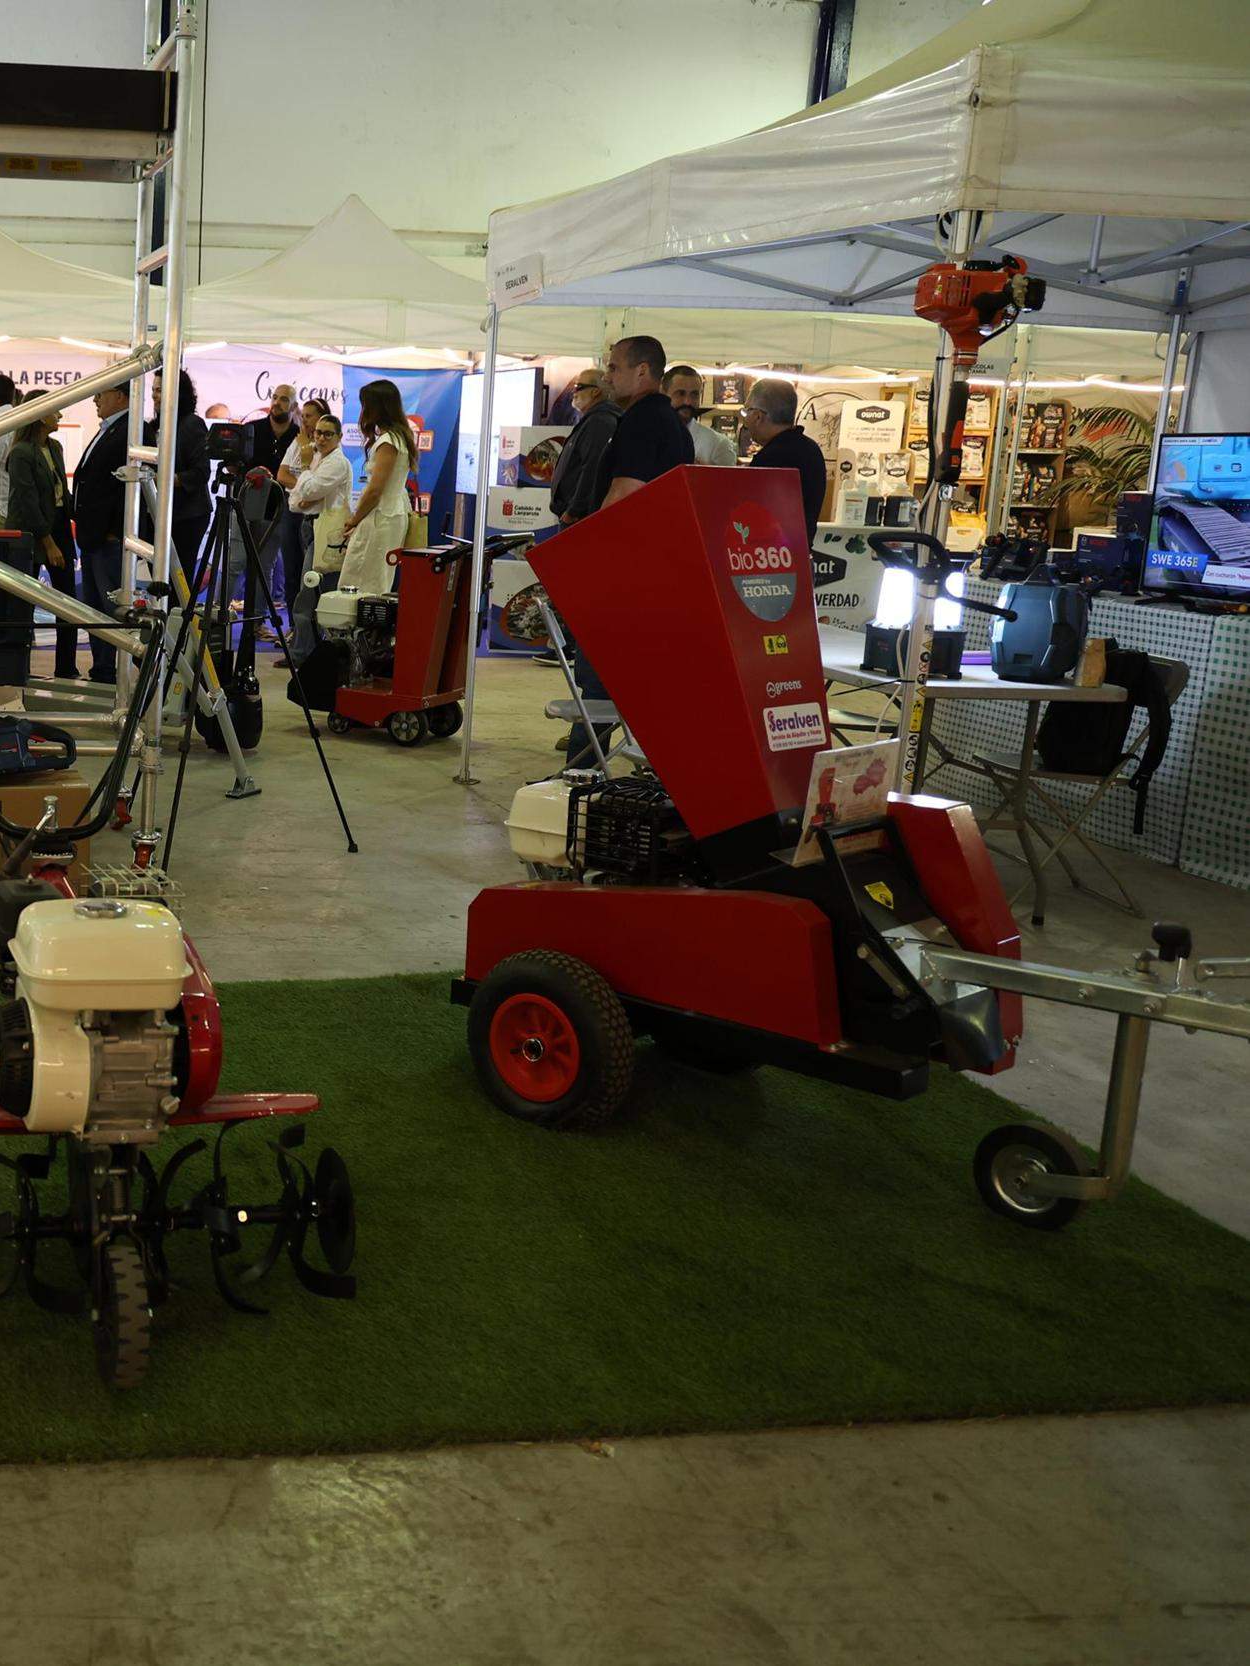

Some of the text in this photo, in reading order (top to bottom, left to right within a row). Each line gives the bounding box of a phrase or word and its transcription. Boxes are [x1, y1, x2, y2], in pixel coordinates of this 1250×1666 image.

[505, 274, 528, 290] SERALVEN
[34, 371, 83, 386] PESCA
[861, 410, 885, 419] ownat
[1151, 553, 1173, 566] SWE
[743, 584, 791, 598] HONDA
[815, 593, 860, 608] VERDAD
[773, 680, 802, 695] greens
[767, 709, 821, 733] Seralven
